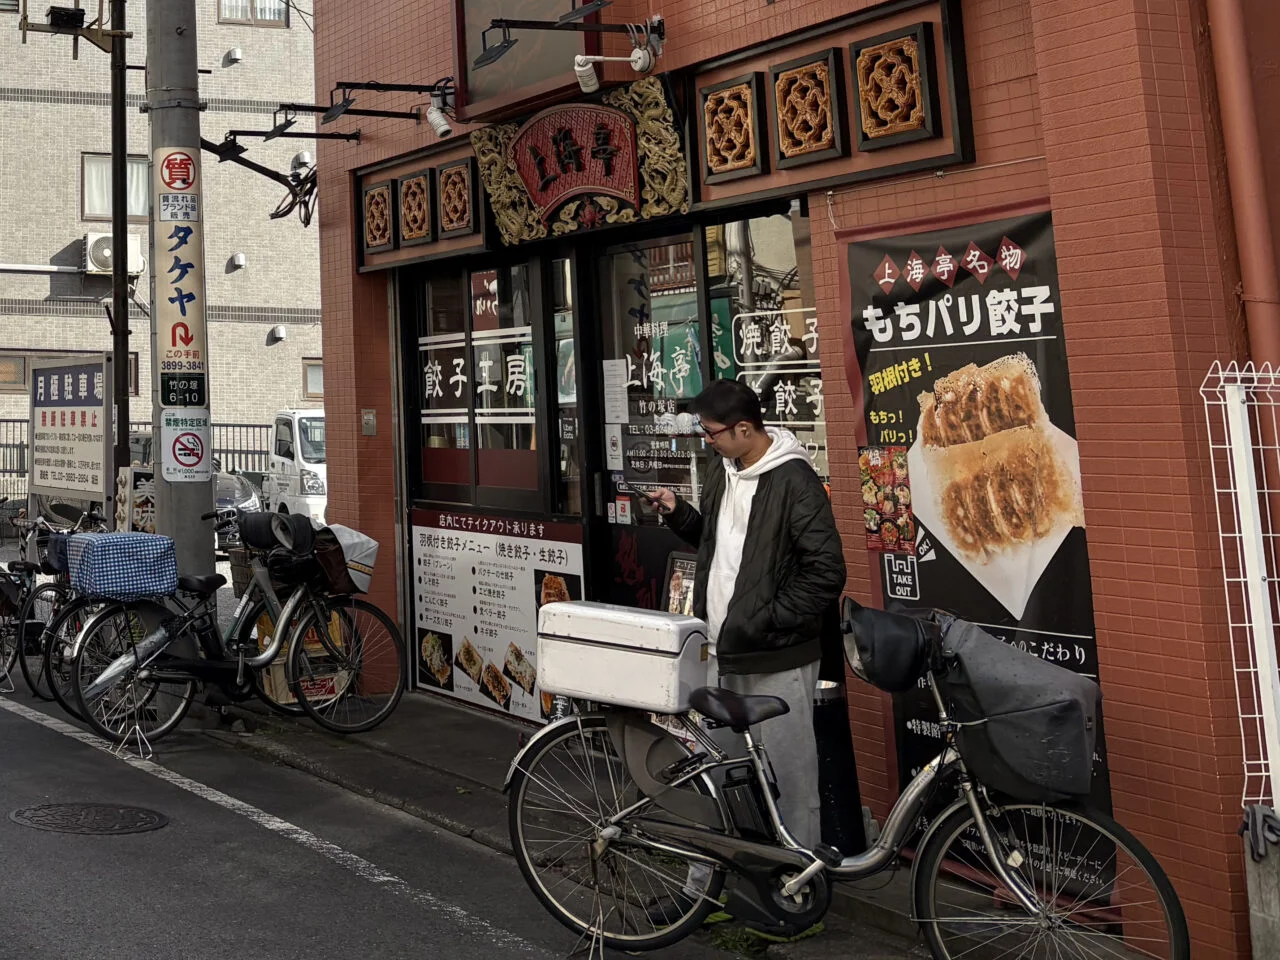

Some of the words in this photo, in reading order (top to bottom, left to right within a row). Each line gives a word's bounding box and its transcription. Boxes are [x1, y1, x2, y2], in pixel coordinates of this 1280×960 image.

[168, 225, 196, 317] タケヤ
[878, 245, 1022, 286] 上海亭名物
[863, 286, 1055, 343] もちパリ餃子
[634, 321, 668, 339] 中華料理
[166, 350, 199, 359] この手前
[161, 361, 204, 370] 3899-3841
[622, 345, 691, 395] 上海亭
[424, 355, 526, 398] 餃子工房
[169, 380, 198, 390] 竹の塚
[169, 393, 198, 402] 6-10
[639, 400, 675, 413] 竹の塚店
[439, 514, 545, 537] 店内にてテイクアウト承ります
[892, 573, 912, 585] TAKE
[896, 586, 911, 596] OUT
